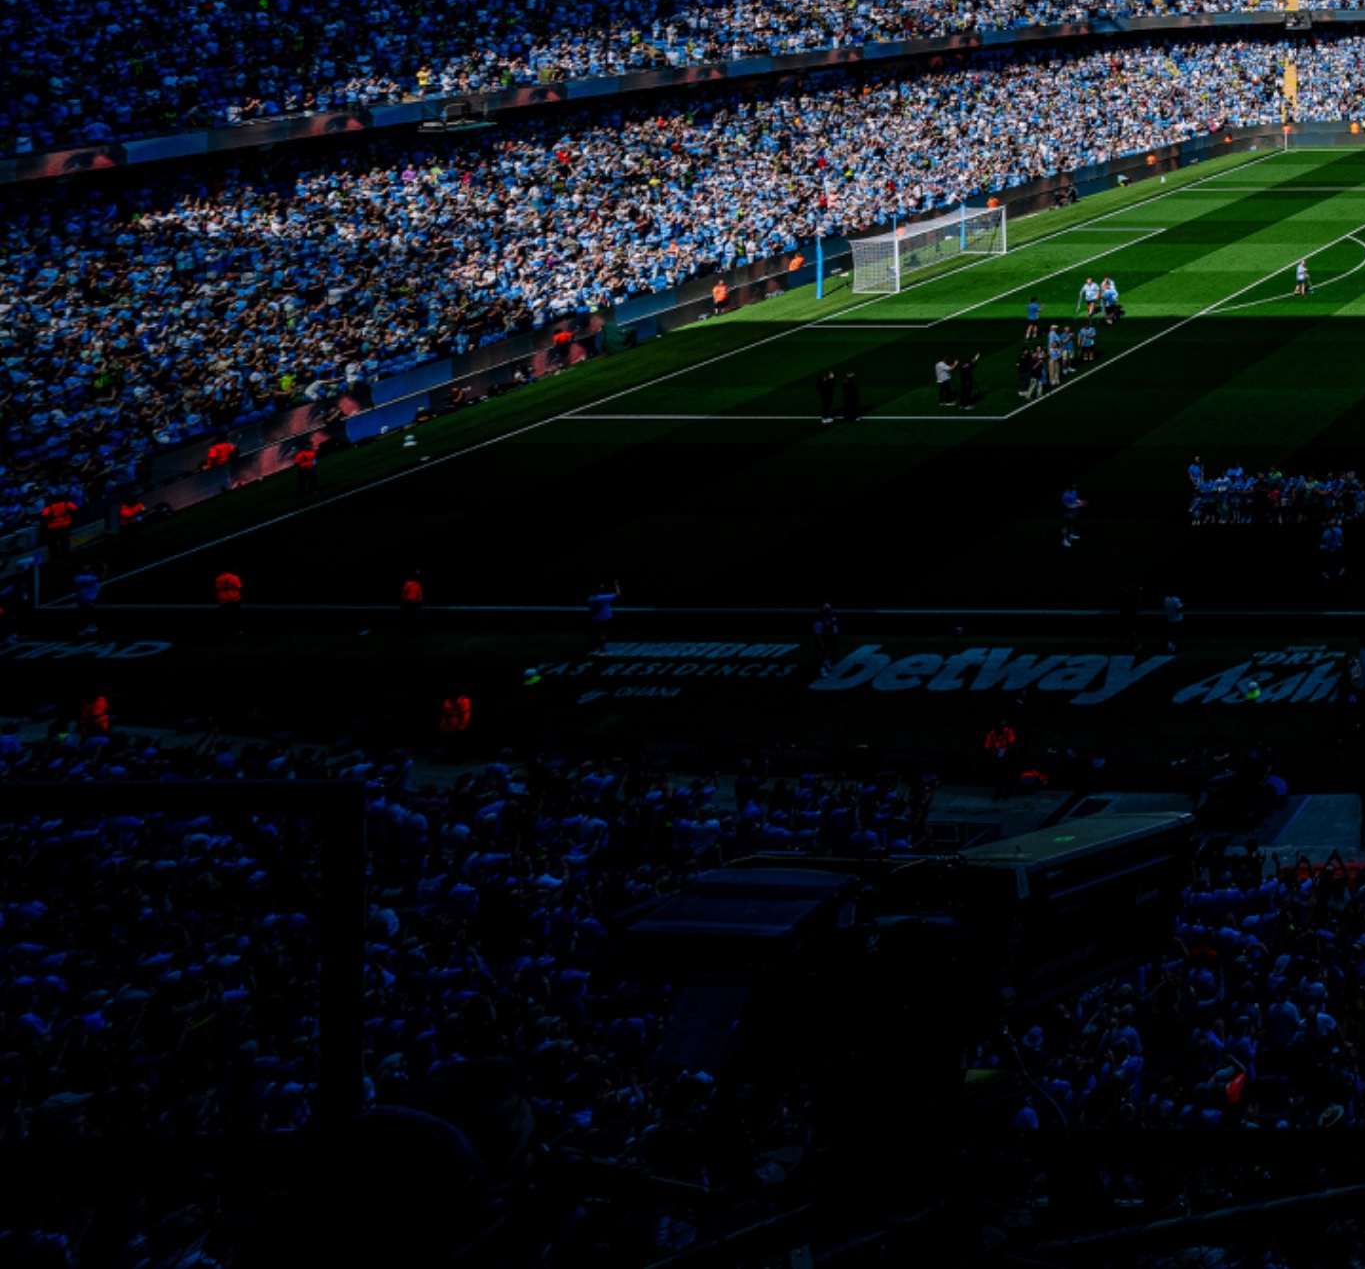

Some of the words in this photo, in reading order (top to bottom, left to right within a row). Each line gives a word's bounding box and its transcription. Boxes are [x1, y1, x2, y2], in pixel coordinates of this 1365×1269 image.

[0, 640, 175, 661] TIHAD
[599, 661, 800, 678] RESIDENCES
[806, 642, 1178, 707] betway
[1170, 659, 1342, 705] Asah
